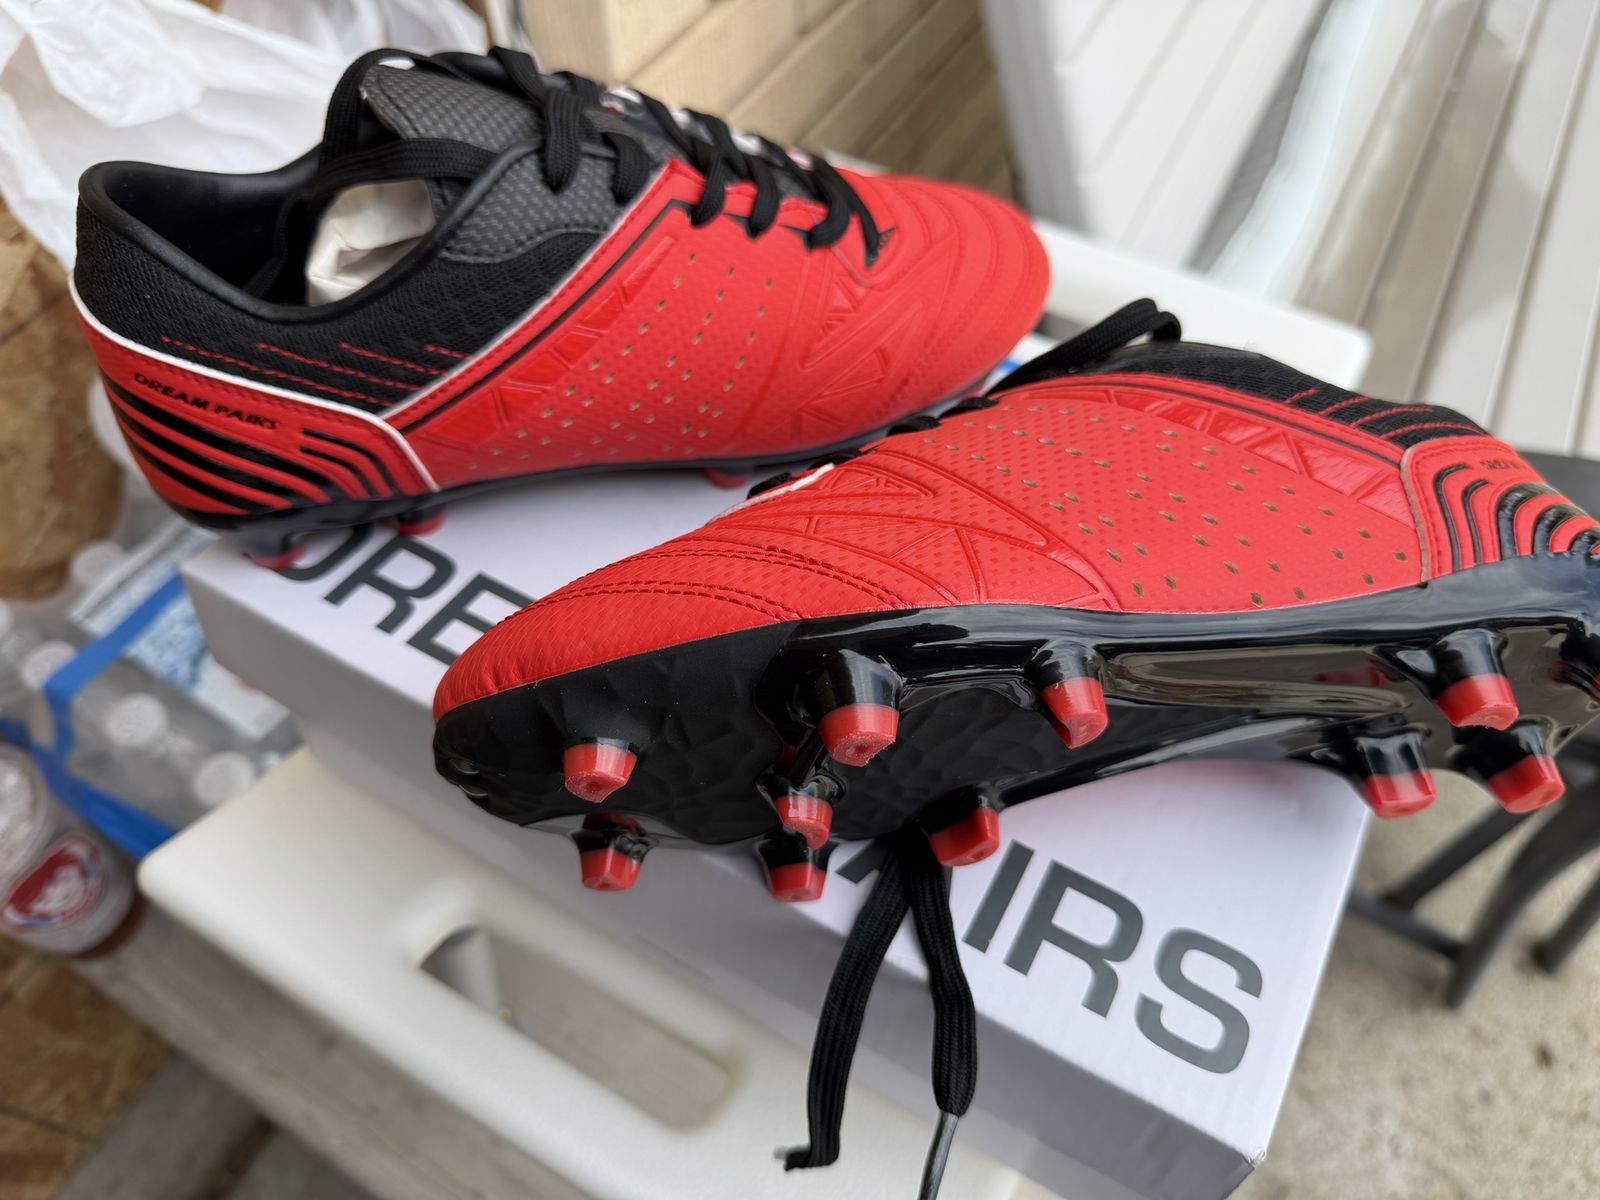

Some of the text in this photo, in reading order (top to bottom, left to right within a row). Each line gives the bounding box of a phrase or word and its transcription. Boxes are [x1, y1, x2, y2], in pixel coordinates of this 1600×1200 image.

[134, 372, 208, 411] DREAM
[272, 521, 1263, 1074] DRE IRS
